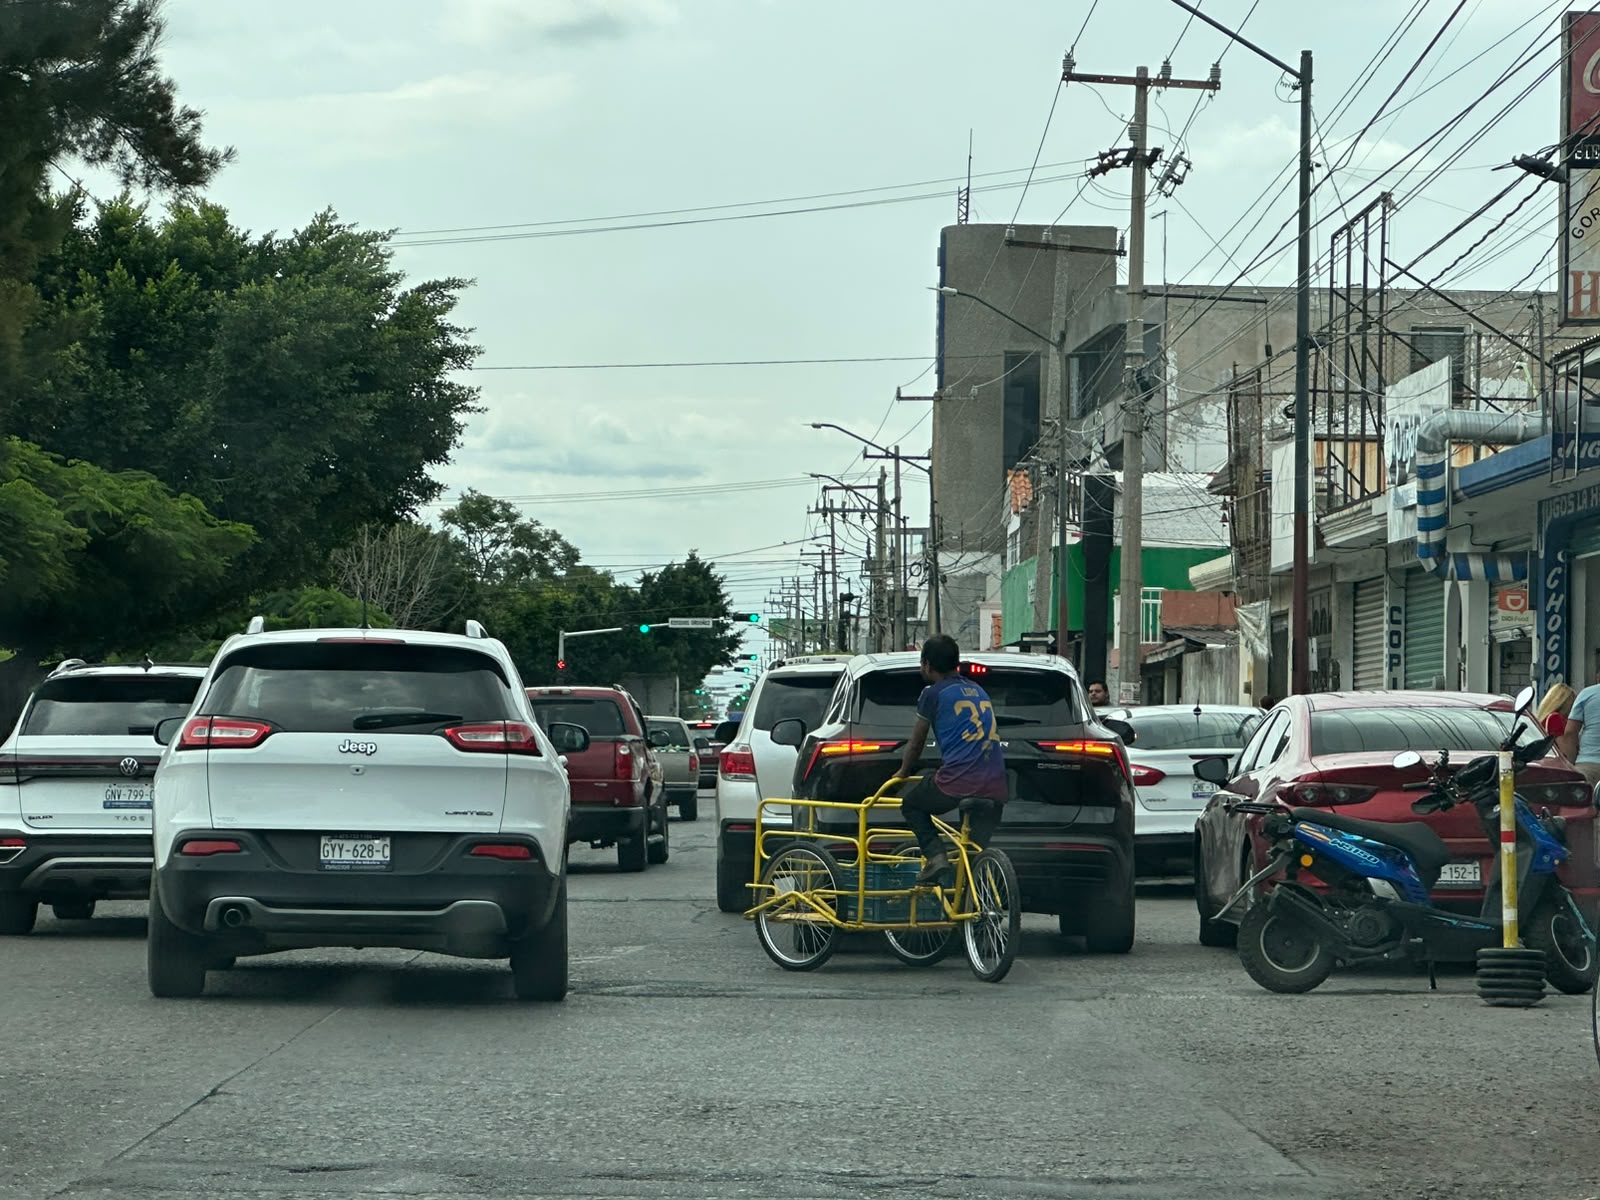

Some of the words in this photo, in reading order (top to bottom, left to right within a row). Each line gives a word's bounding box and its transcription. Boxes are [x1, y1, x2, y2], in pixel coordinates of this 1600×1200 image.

[1571, 207, 1600, 240] GOR
[954, 700, 1000, 742] 32
[338, 739, 377, 756] Jeep
[105, 789, 154, 800] GNV-799-C
[322, 842, 389, 859] GYY-628-C
[1441, 866, 1480, 880] -152-F
